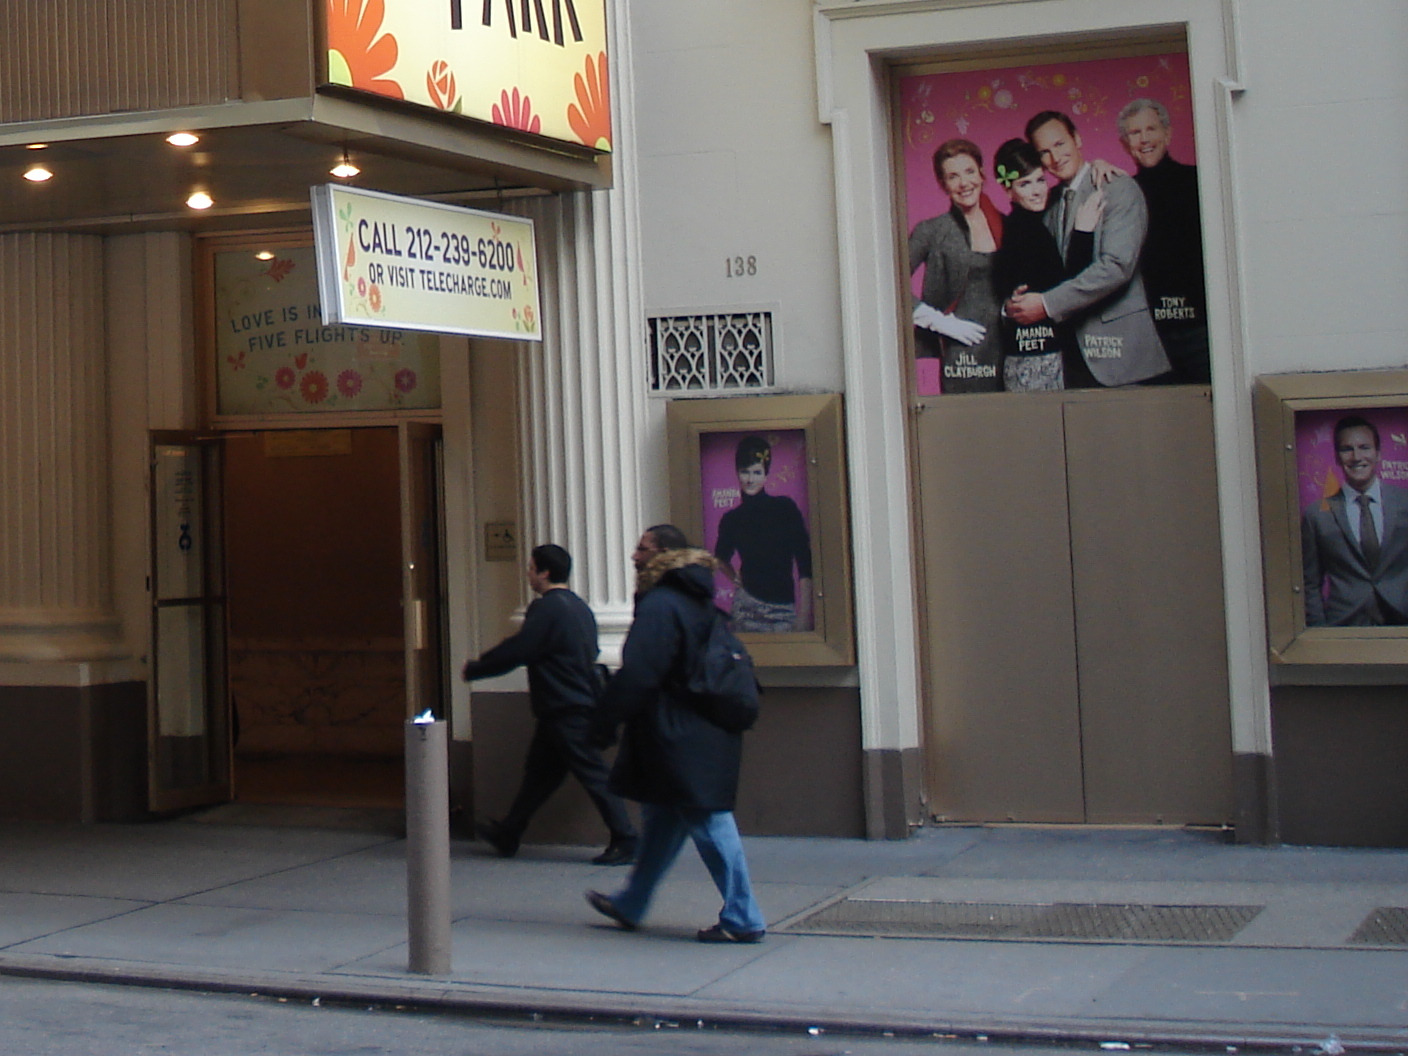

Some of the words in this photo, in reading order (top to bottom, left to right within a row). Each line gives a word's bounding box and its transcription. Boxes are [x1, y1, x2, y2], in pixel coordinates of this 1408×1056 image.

[358, 218, 402, 257] CALL
[405, 226, 515, 274] 212-239-6200
[726, 255, 757, 278] 138
[369, 262, 384, 285] OR
[387, 265, 416, 289] VISIT
[419, 269, 512, 300] TELECHARGE.COM
[1160, 297, 1186, 308] TONY
[231, 309, 274, 333] LOVE
[282, 306, 298, 322] IS
[1154, 307, 1195, 320] ROBERTS
[248, 331, 286, 352] FIVE
[294, 327, 370, 344] FLIGHTS
[1016, 325, 1054, 340] AMANDA
[1018, 339, 1046, 352] PEET
[1084, 334, 1124, 347] PATRICK
[1083, 346, 1122, 359] WILSON
[944, 365, 996, 378] CLAYBURGH
